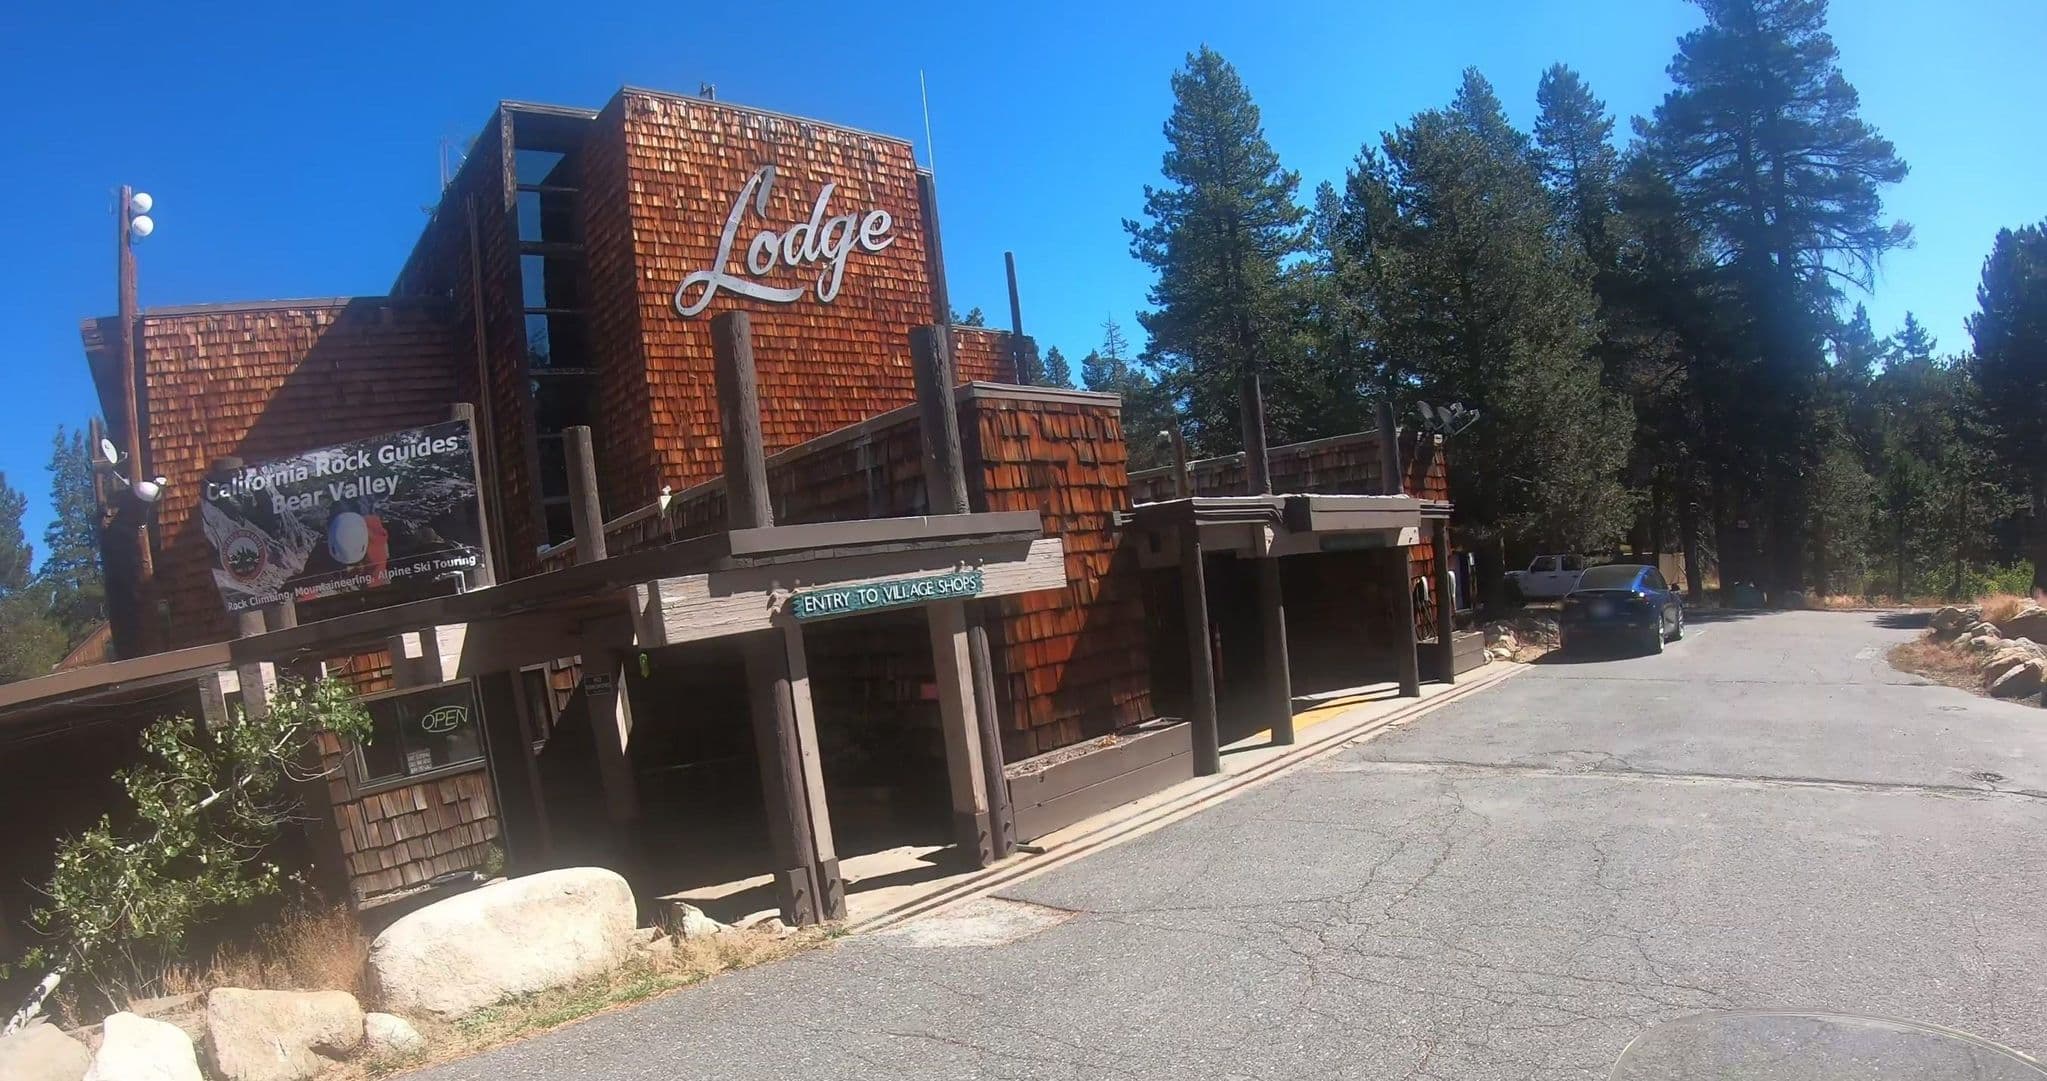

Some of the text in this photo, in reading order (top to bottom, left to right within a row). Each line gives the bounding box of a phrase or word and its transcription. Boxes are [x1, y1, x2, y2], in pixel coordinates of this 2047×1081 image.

[675, 165, 897, 316] Lodge
[206, 434, 459, 501] California Rock Guides
[272, 474, 399, 514] Bear Valley
[227, 599, 248, 611] Rock
[249, 590, 294, 607] Climbing,
[377, 565, 411, 580] Alpine
[413, 560, 430, 574] Ski
[432, 554, 477, 570] Touring
[804, 575, 977, 612] ENTRY TO VILLAGE SHOPS
[422, 706, 468, 730] OPEN
